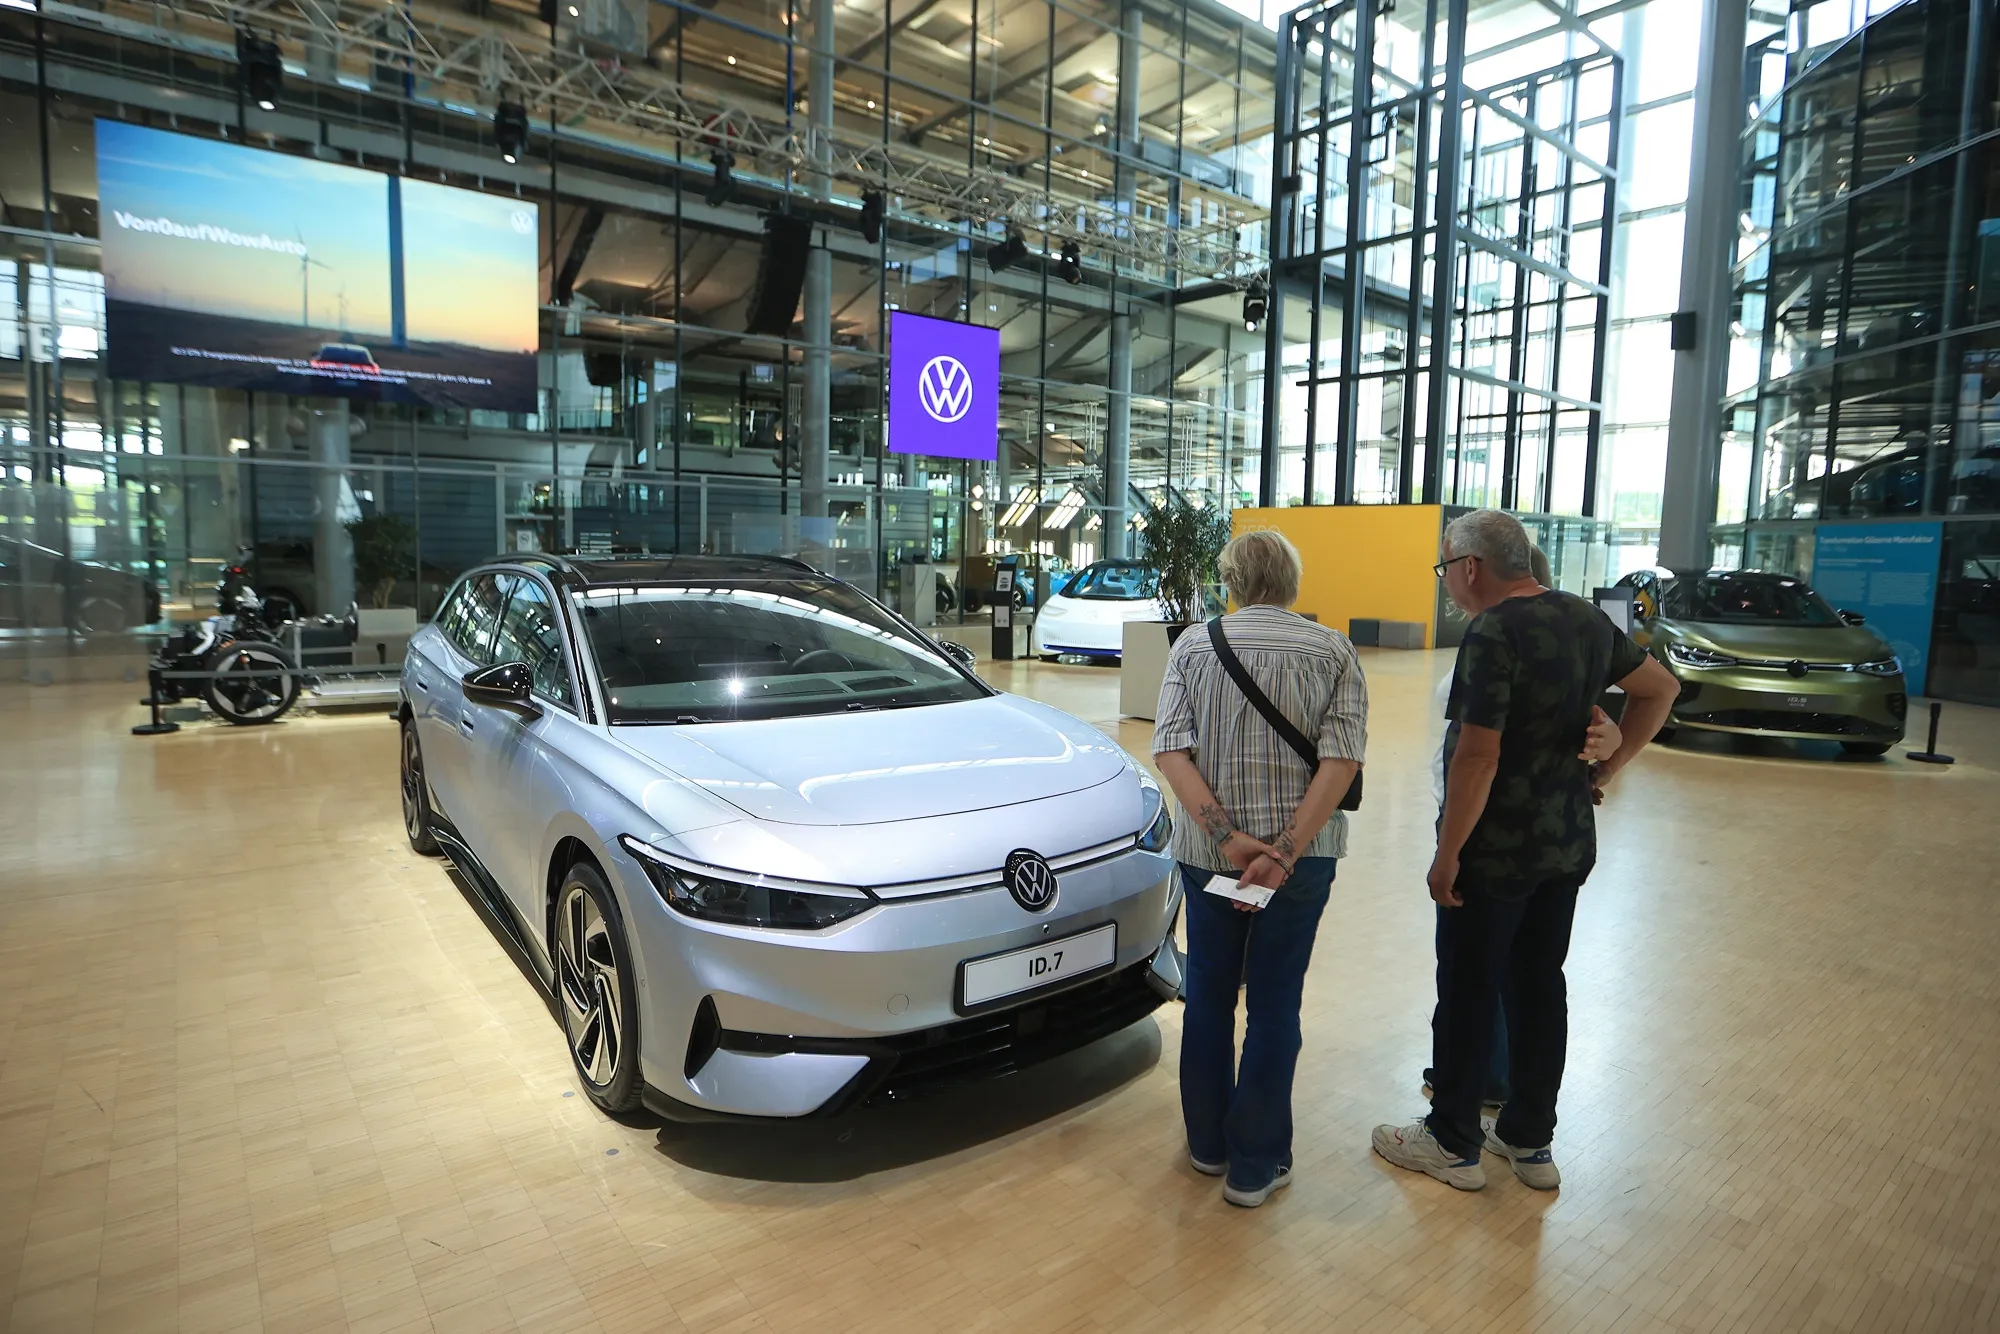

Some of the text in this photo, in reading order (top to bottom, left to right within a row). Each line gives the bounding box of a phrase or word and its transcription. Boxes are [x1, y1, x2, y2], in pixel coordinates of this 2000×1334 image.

[919, 355, 973, 423] VW
[1015, 859, 1052, 906] VW
[1028, 951, 1064, 978] ID.7
